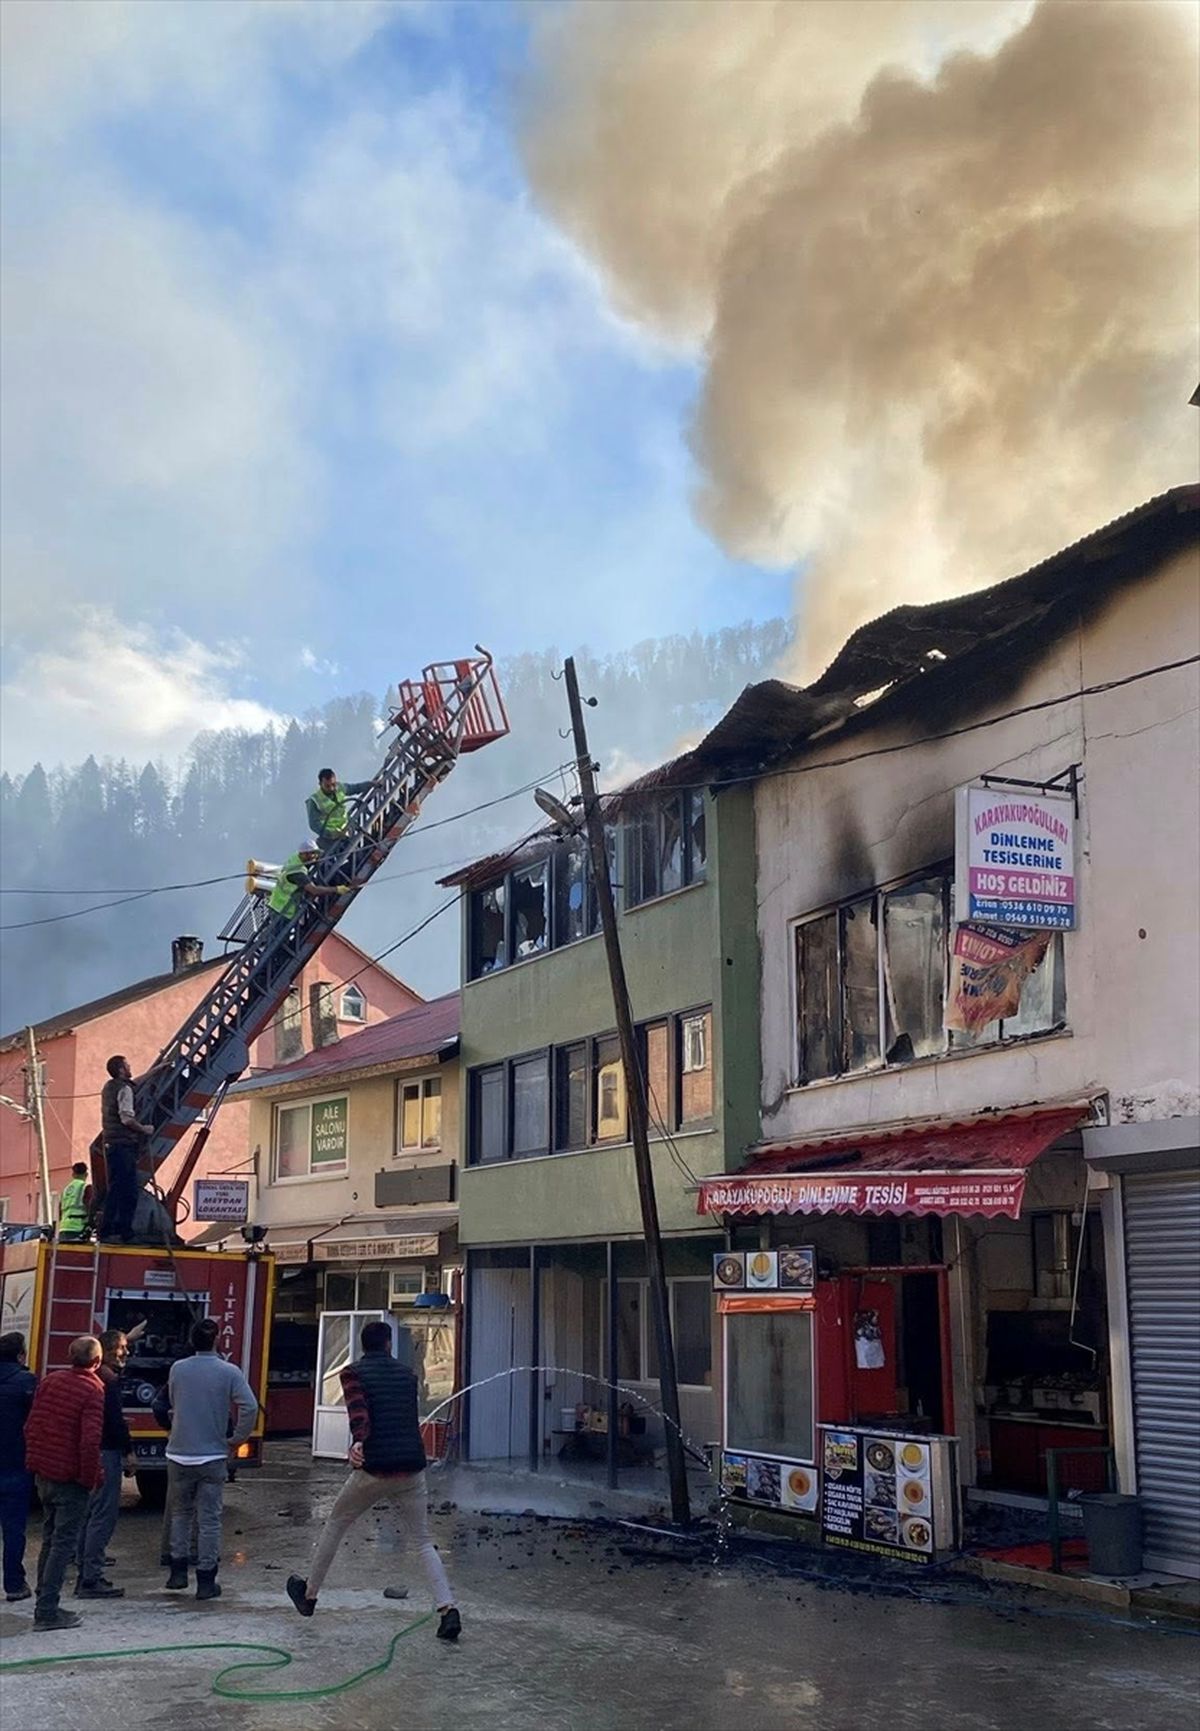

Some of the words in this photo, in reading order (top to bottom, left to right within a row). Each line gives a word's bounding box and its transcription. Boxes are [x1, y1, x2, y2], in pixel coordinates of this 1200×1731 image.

[974, 803, 1069, 845] KARAYAKUPOĞULLARI
[990, 833, 1055, 852] DİNLENME
[982, 850, 1063, 870] TESİSLERİNE
[976, 873, 1006, 895] HOŞ
[1007, 875, 1068, 897] GELDİNİZ
[1026, 903, 1043, 912] 610
[323, 1105, 339, 1120] AİLE
[315, 1121, 345, 1137] SALONU
[316, 1136, 344, 1152] VARDIR
[799, 1183, 857, 1204] DİNLENME
[865, 1182, 908, 1205] TESİSİ
[221, 1282, 237, 1361] İTFAİY
